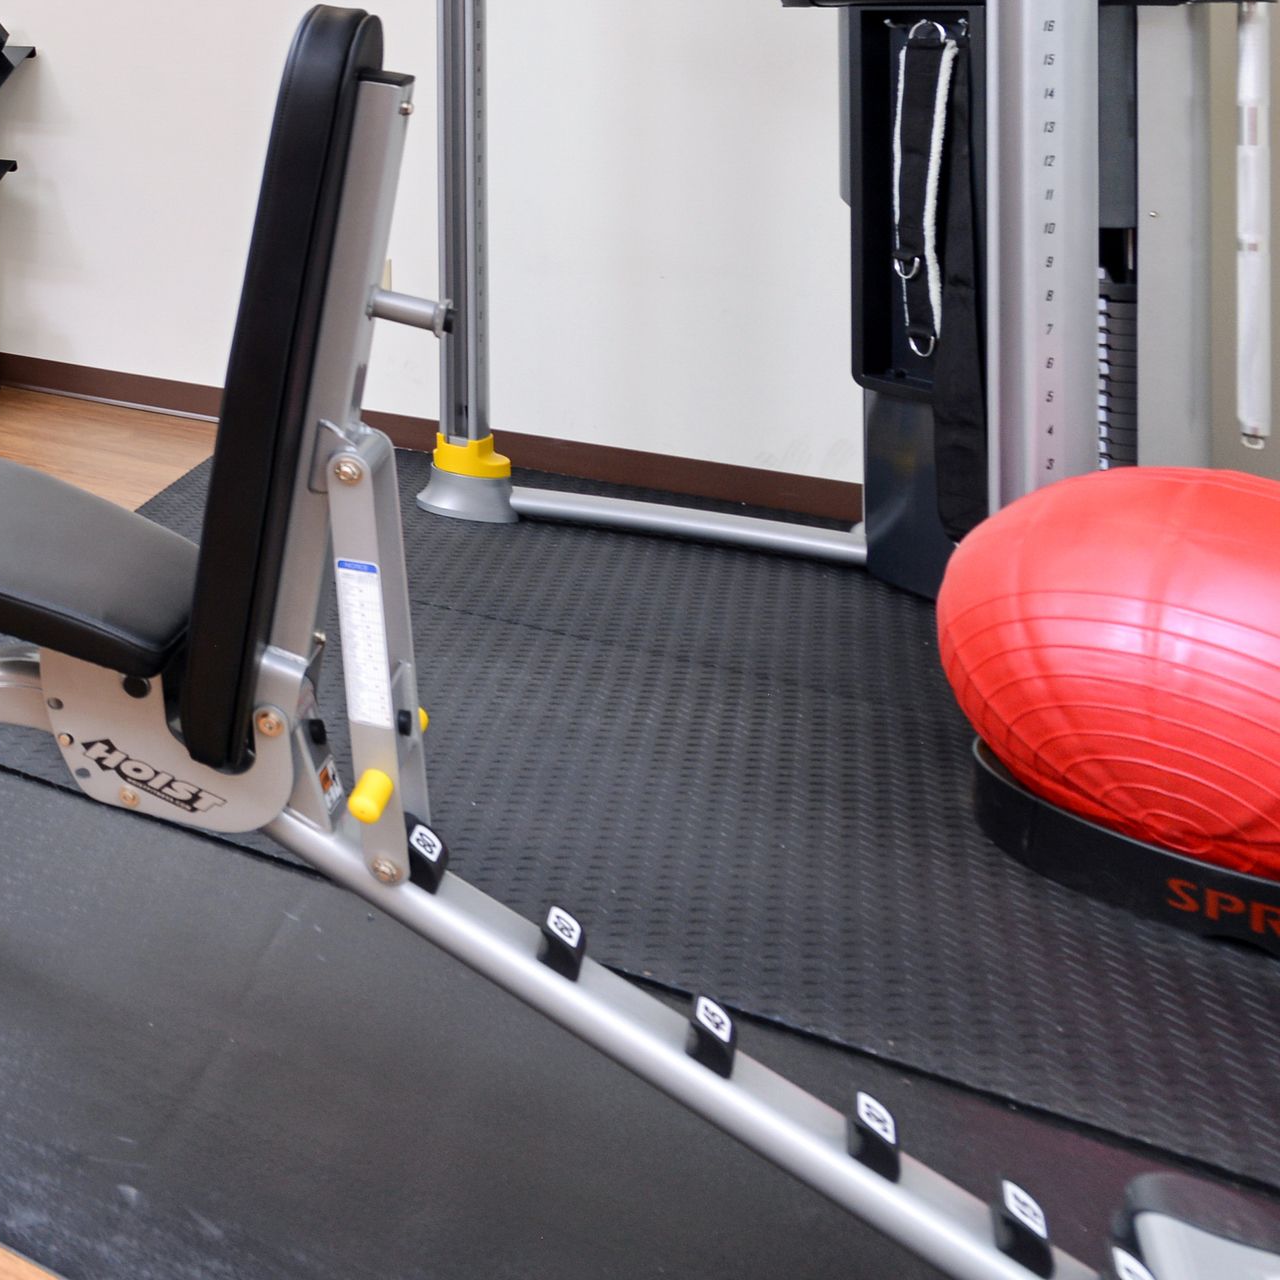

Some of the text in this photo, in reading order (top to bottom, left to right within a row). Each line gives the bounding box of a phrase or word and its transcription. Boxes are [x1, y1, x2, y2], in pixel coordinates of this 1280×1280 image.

[1042, 19, 1056, 33] 16
[1042, 53, 1055, 66] 15
[1043, 87, 1055, 100] 14
[1043, 120, 1056, 134] 13
[1043, 154, 1056, 168] 12
[1044, 188, 1055, 201] 11
[1043, 222, 1057, 235] 10
[1045, 255, 1054, 269] 9
[1045, 289, 1055, 302] 8
[1046, 322, 1054, 335] 7
[1045, 356, 1055, 370] 6
[1045, 390, 1054, 403] 5
[1046, 424, 1054, 436] 4
[1045, 457, 1055, 471] 3
[82, 740, 228, 812] HOIST
